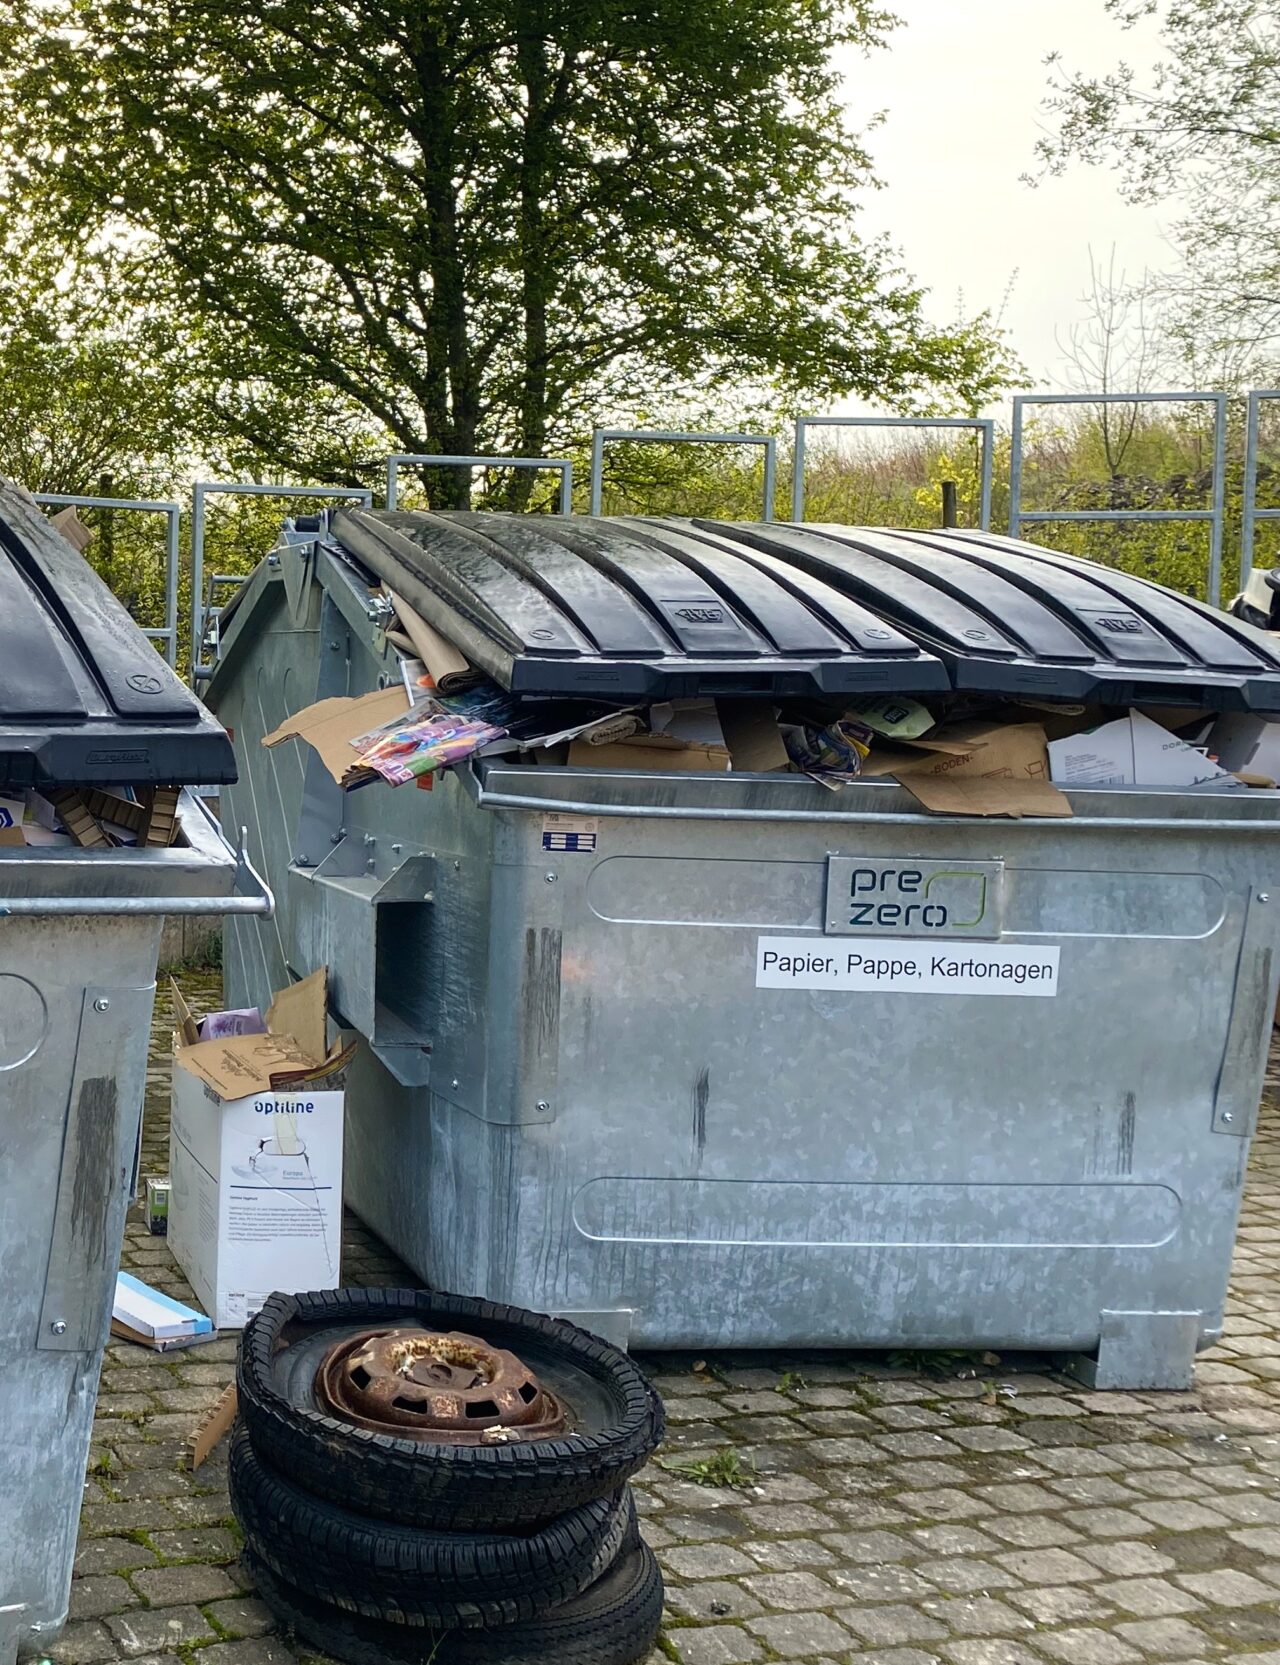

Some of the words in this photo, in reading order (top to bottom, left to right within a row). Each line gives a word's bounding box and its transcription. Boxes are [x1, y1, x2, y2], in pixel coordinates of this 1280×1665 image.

[851, 868, 923, 898] pre
[849, 902, 948, 928] zero
[763, 951, 838, 977] Papier,
[848, 953, 922, 980] Pappe,
[931, 957, 1053, 984] Kartonagen
[254, 1100, 314, 1115] optiline
